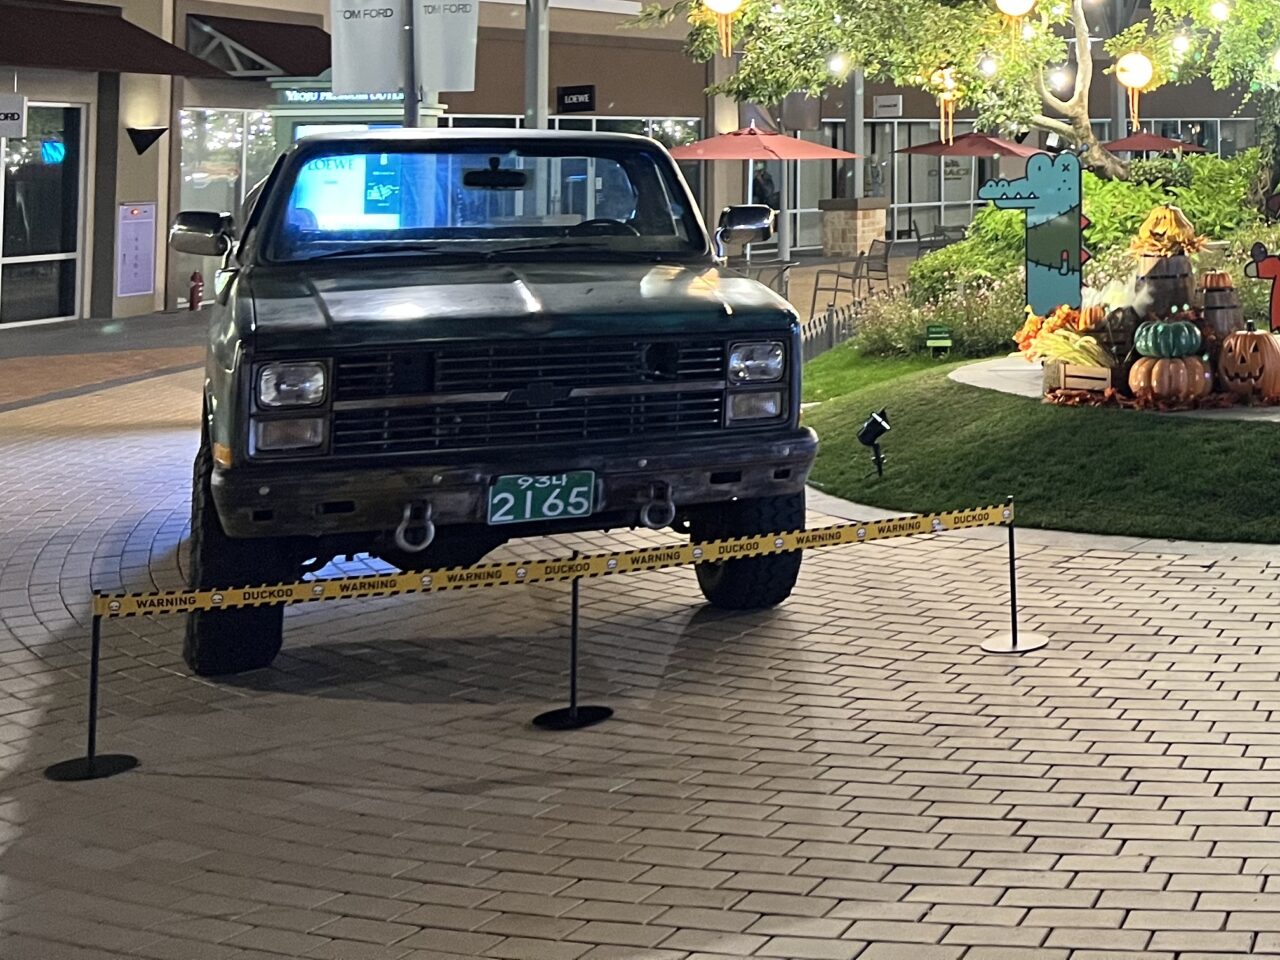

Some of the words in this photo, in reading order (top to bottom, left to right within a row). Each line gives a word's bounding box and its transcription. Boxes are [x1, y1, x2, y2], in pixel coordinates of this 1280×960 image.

[363, 8, 393, 18] FORD
[422, 4, 441, 15] TOM
[443, 3, 472, 14] FORD
[564, 94, 590, 104] LOEWE
[0, 112, 20, 121] ORD
[308, 158, 353, 171] LOEWE
[491, 486, 589, 522] 2165
[136, 596, 197, 609] WARNING
[242, 588, 293, 601] DUCKOO
[339, 579, 397, 593] WARNING
[446, 569, 502, 583] WARNING
[544, 562, 591, 576] DUCKOO
[630, 551, 681, 565] WARNING
[718, 542, 759, 555] DUCKOO
[795, 531, 842, 545] WARNING
[877, 521, 921, 534] WARNING
[953, 513, 990, 525] DUCKOO
